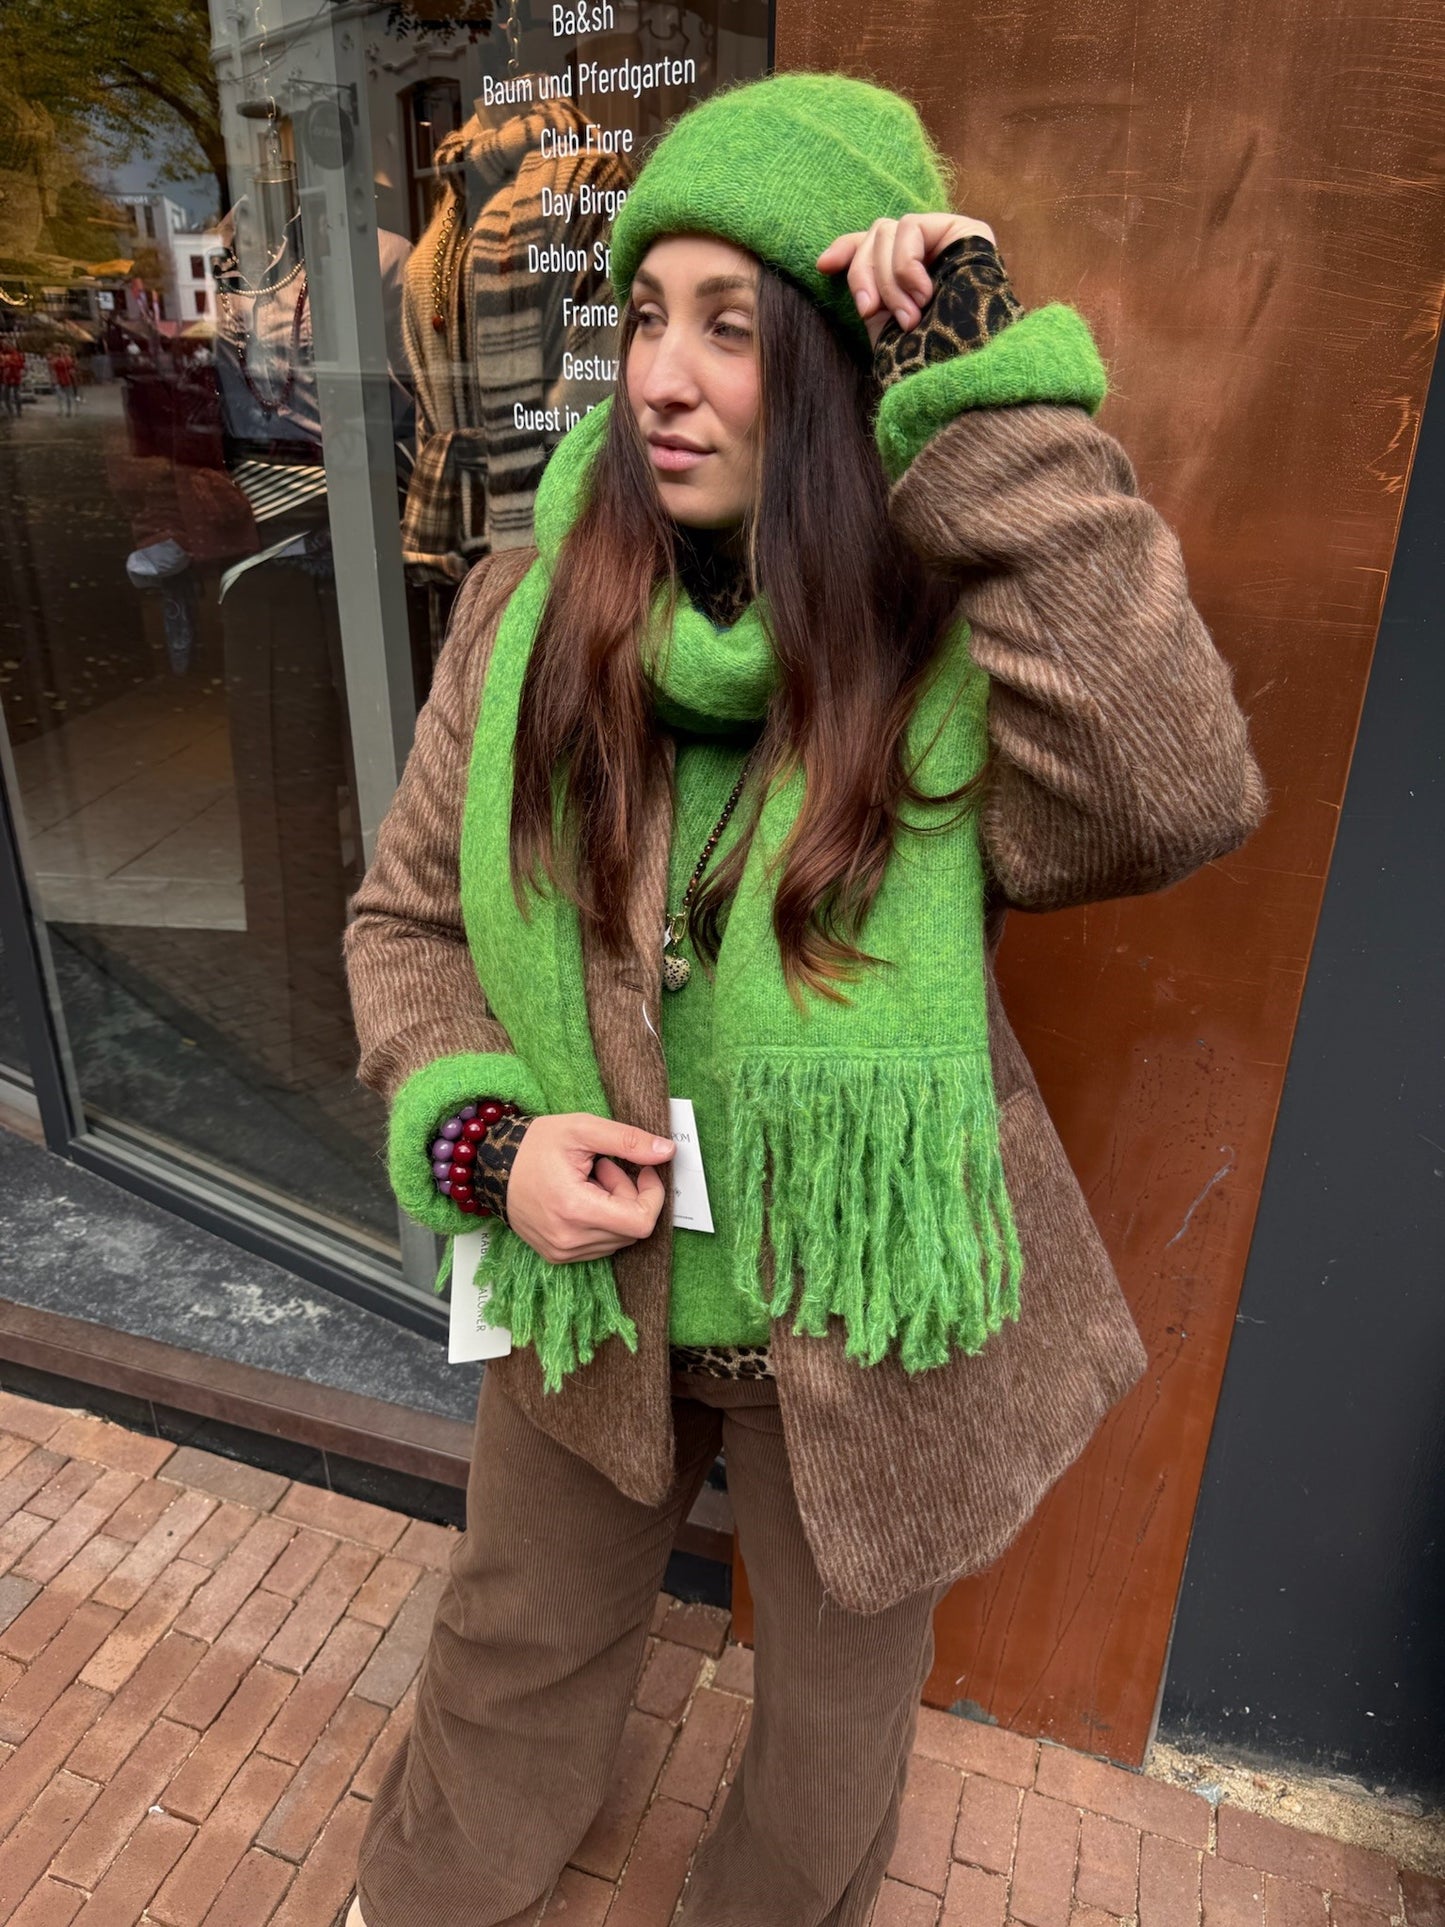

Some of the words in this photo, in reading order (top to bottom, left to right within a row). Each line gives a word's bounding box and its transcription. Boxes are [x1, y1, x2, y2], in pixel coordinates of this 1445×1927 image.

[552, 0, 614, 37] Ba&sh
[482, 74, 533, 106] Baum
[538, 65, 572, 100] und
[578, 56, 696, 99] Pferdgarten
[540, 126, 579, 159] Club
[585, 124, 633, 155] Fiore
[541, 186, 574, 224] Day
[528, 243, 587, 273] Deblon
[563, 298, 618, 327] Frame
[513, 403, 561, 431] Guest
[565, 404, 580, 432] in
